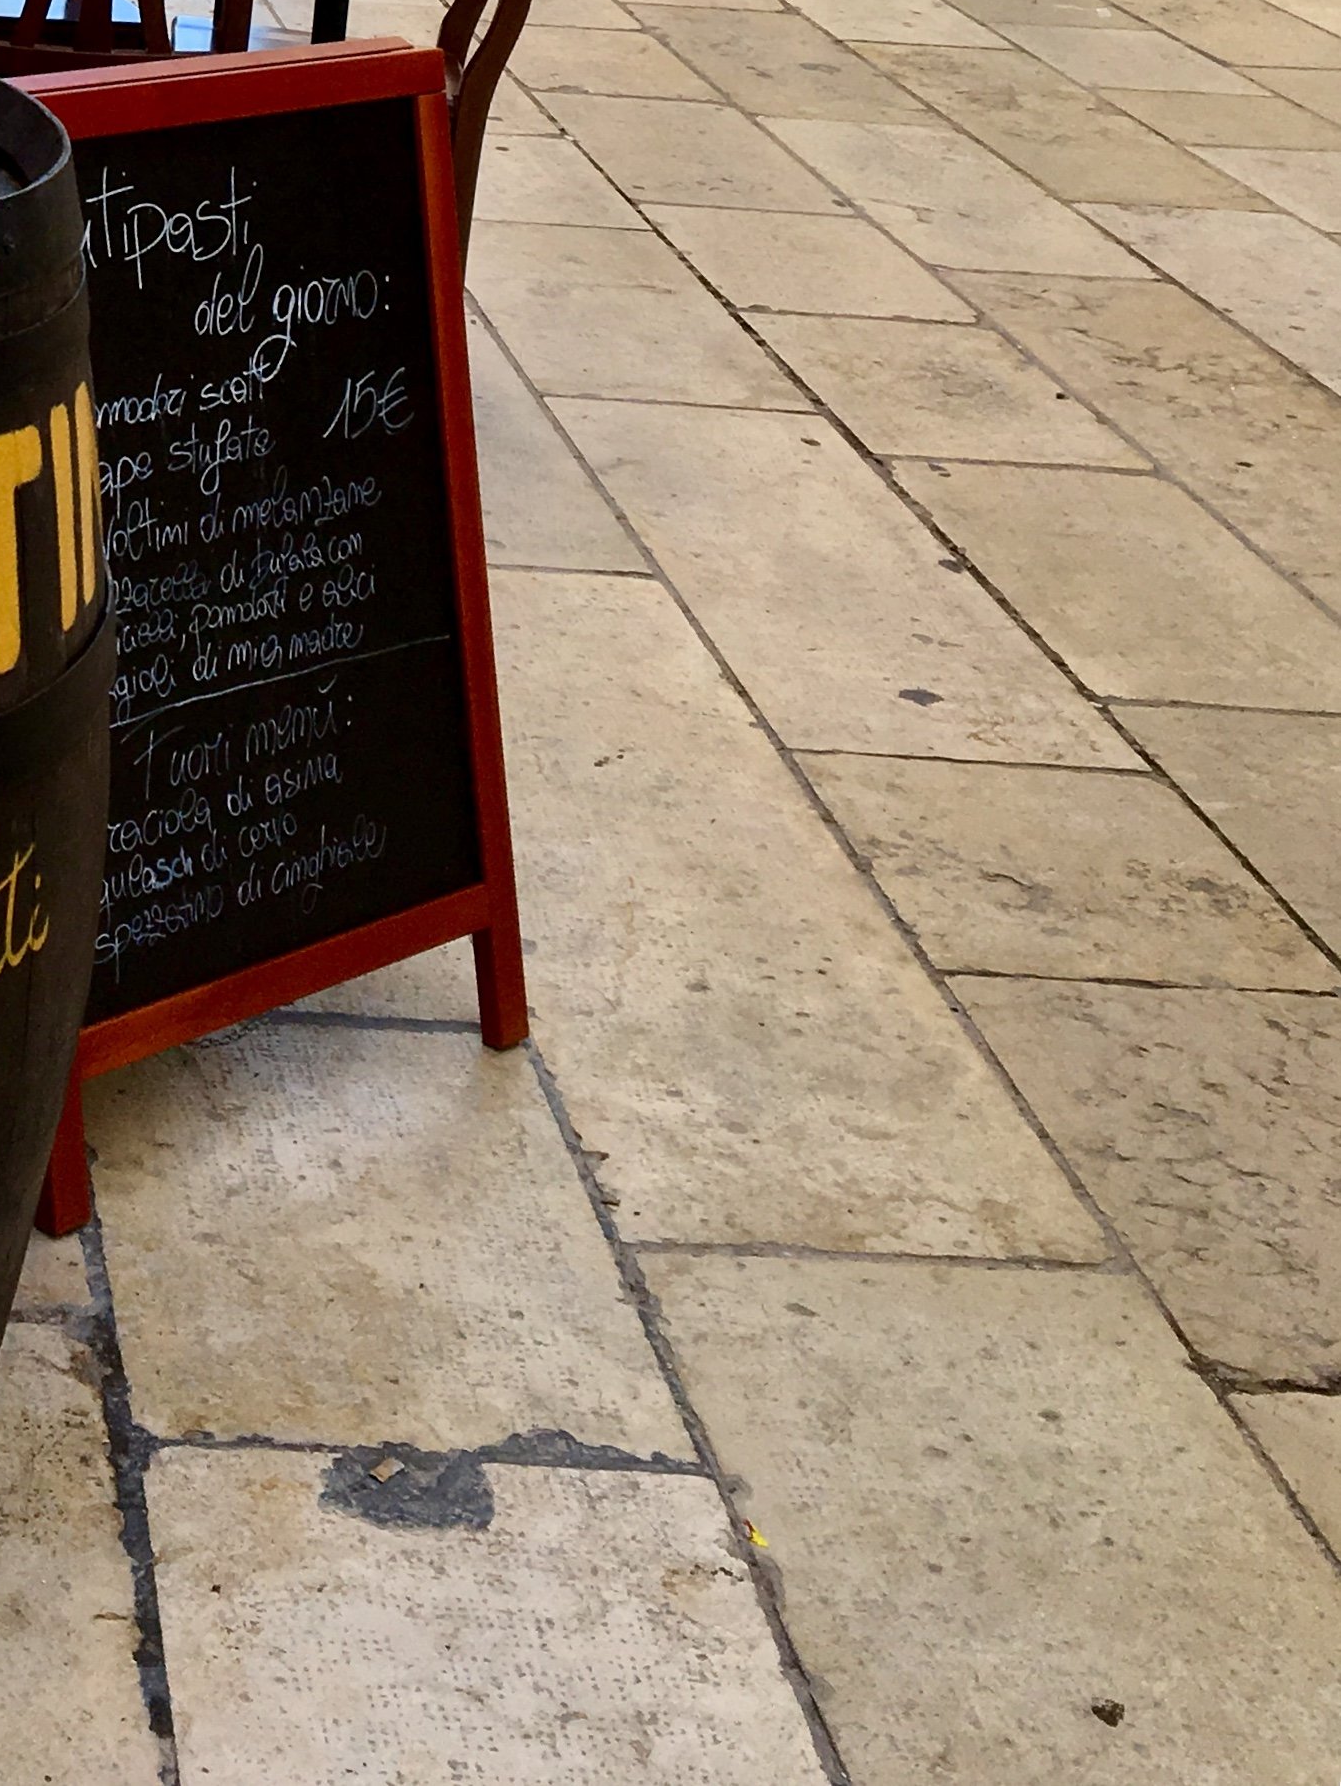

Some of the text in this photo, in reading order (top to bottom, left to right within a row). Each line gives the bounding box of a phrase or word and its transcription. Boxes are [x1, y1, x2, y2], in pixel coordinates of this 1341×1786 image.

[194, 243, 264, 337] del
[199, 492, 226, 544] di
[232, 464, 383, 529] melanzane
[220, 549, 245, 594] di
[327, 531, 363, 565] con
[298, 582, 314, 613] e
[192, 641, 222, 684] di
[227, 634, 283, 671] mia
[288, 612, 364, 662] madre
[225, 775, 254, 816] di
[201, 827, 228, 873] di
[238, 813, 298, 858] cervo
[237, 862, 262, 907] di
